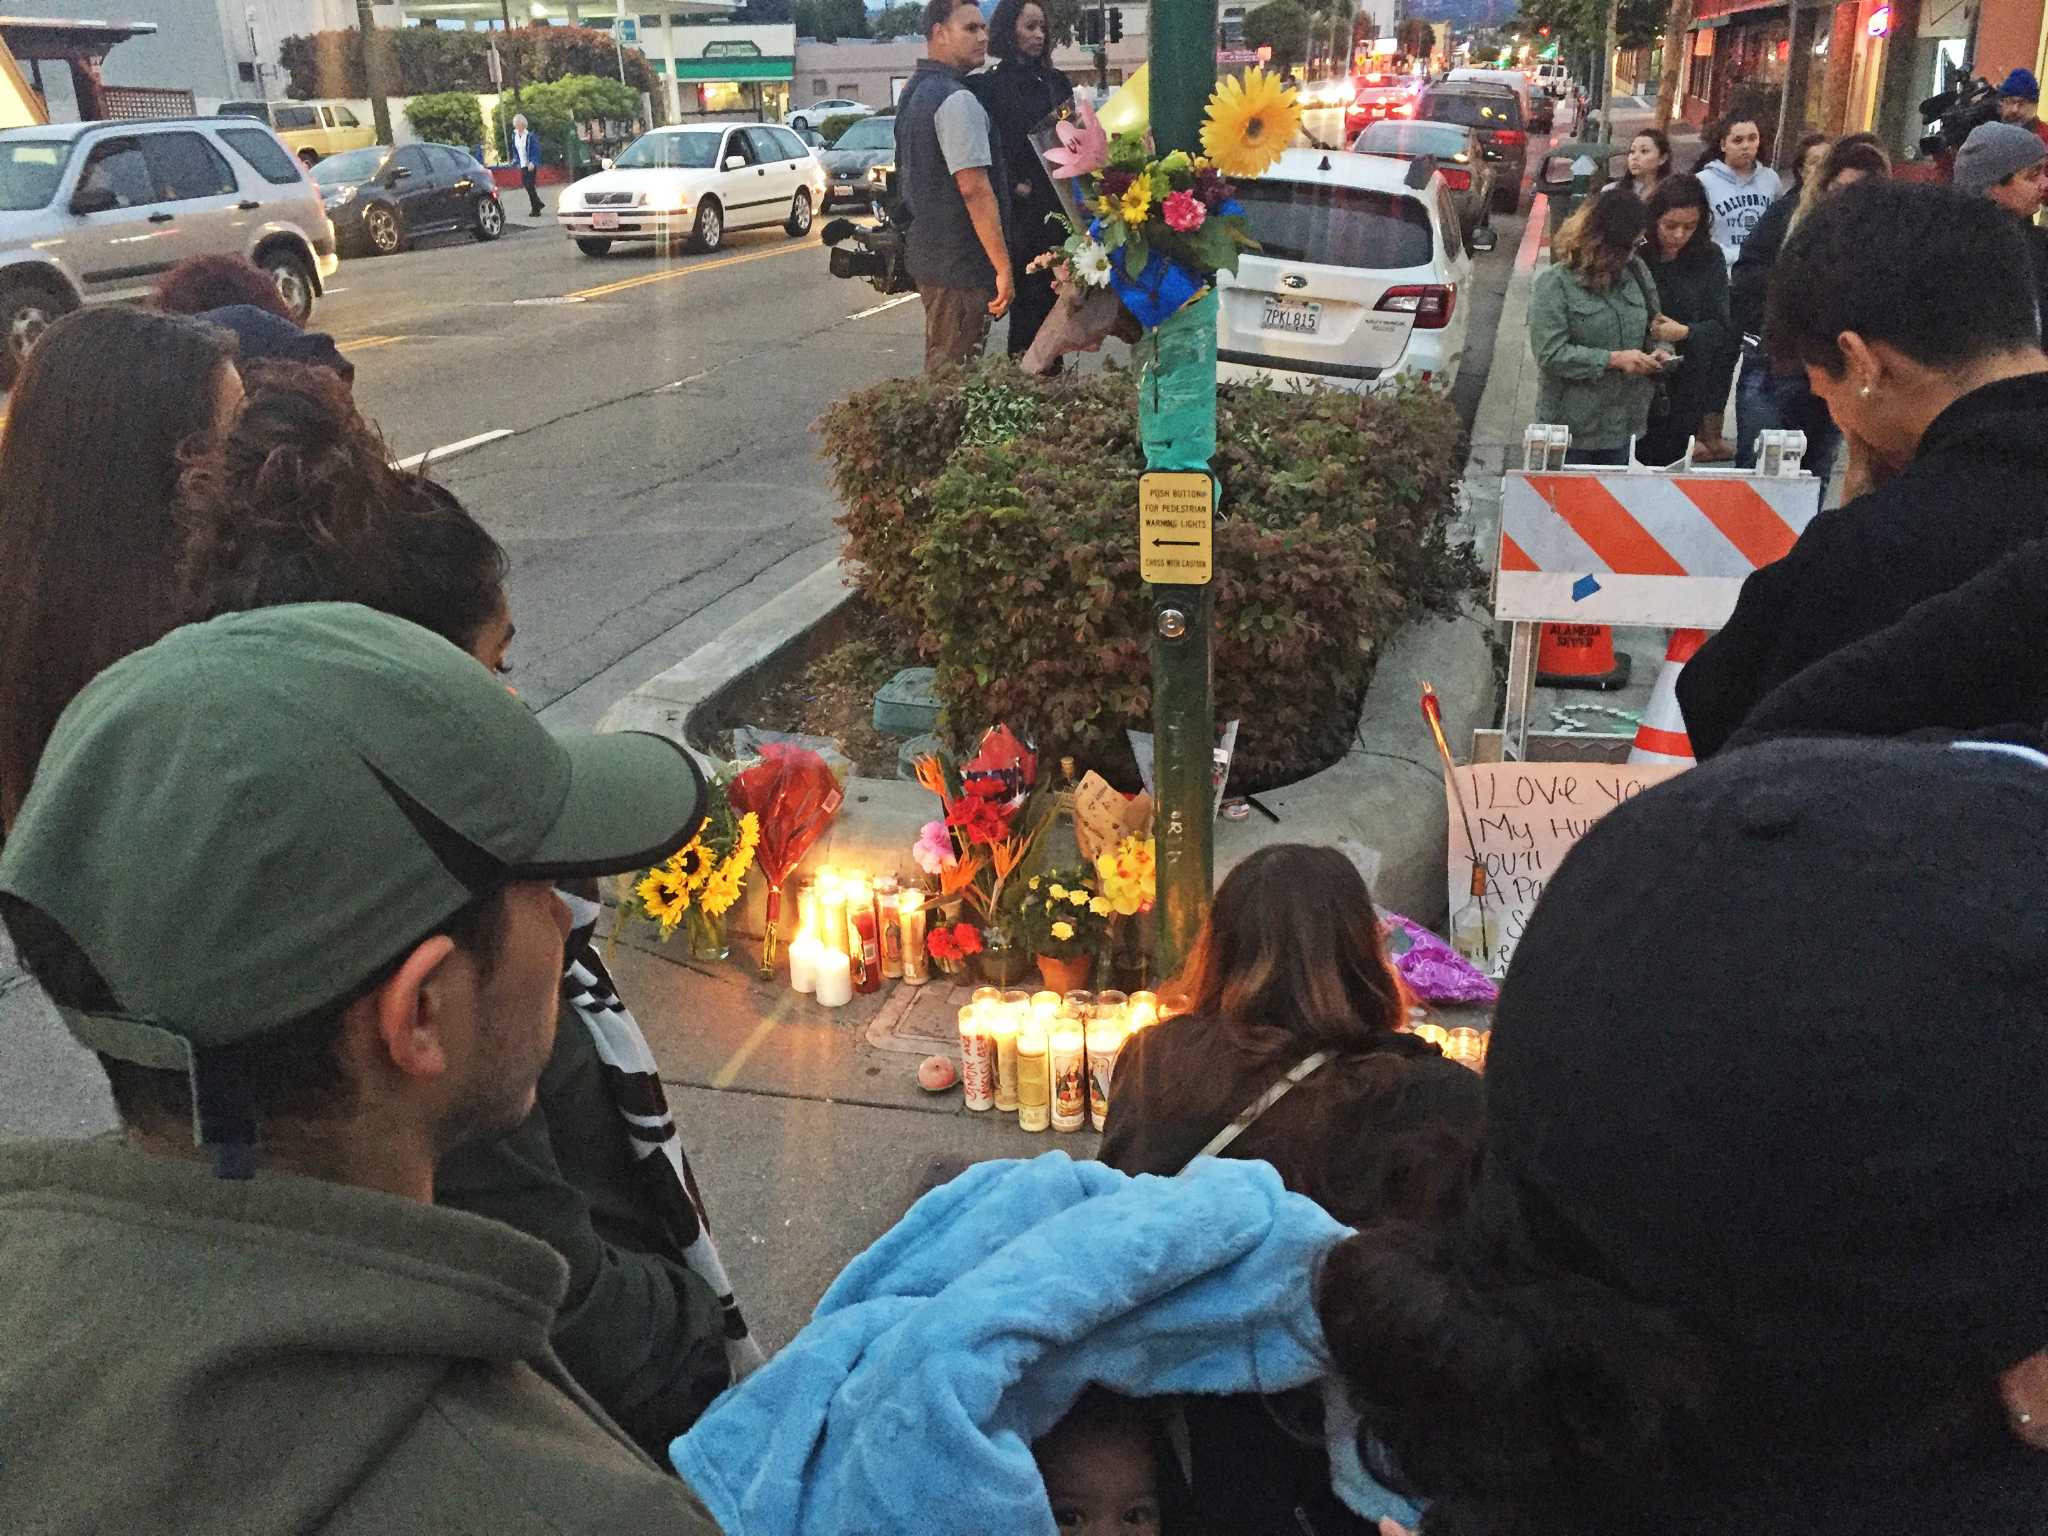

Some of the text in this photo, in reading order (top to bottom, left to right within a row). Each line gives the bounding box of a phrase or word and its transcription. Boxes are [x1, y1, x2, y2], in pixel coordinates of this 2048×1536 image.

[1263, 308, 1316, 329] 7PKL815
[1150, 489, 1202, 498] PUSH BUTTON
[1144, 504, 1207, 513] FOR PEDESTRIAN
[1145, 519, 1207, 529] WARNING LIGHTS
[1550, 817, 1601, 840] HU
